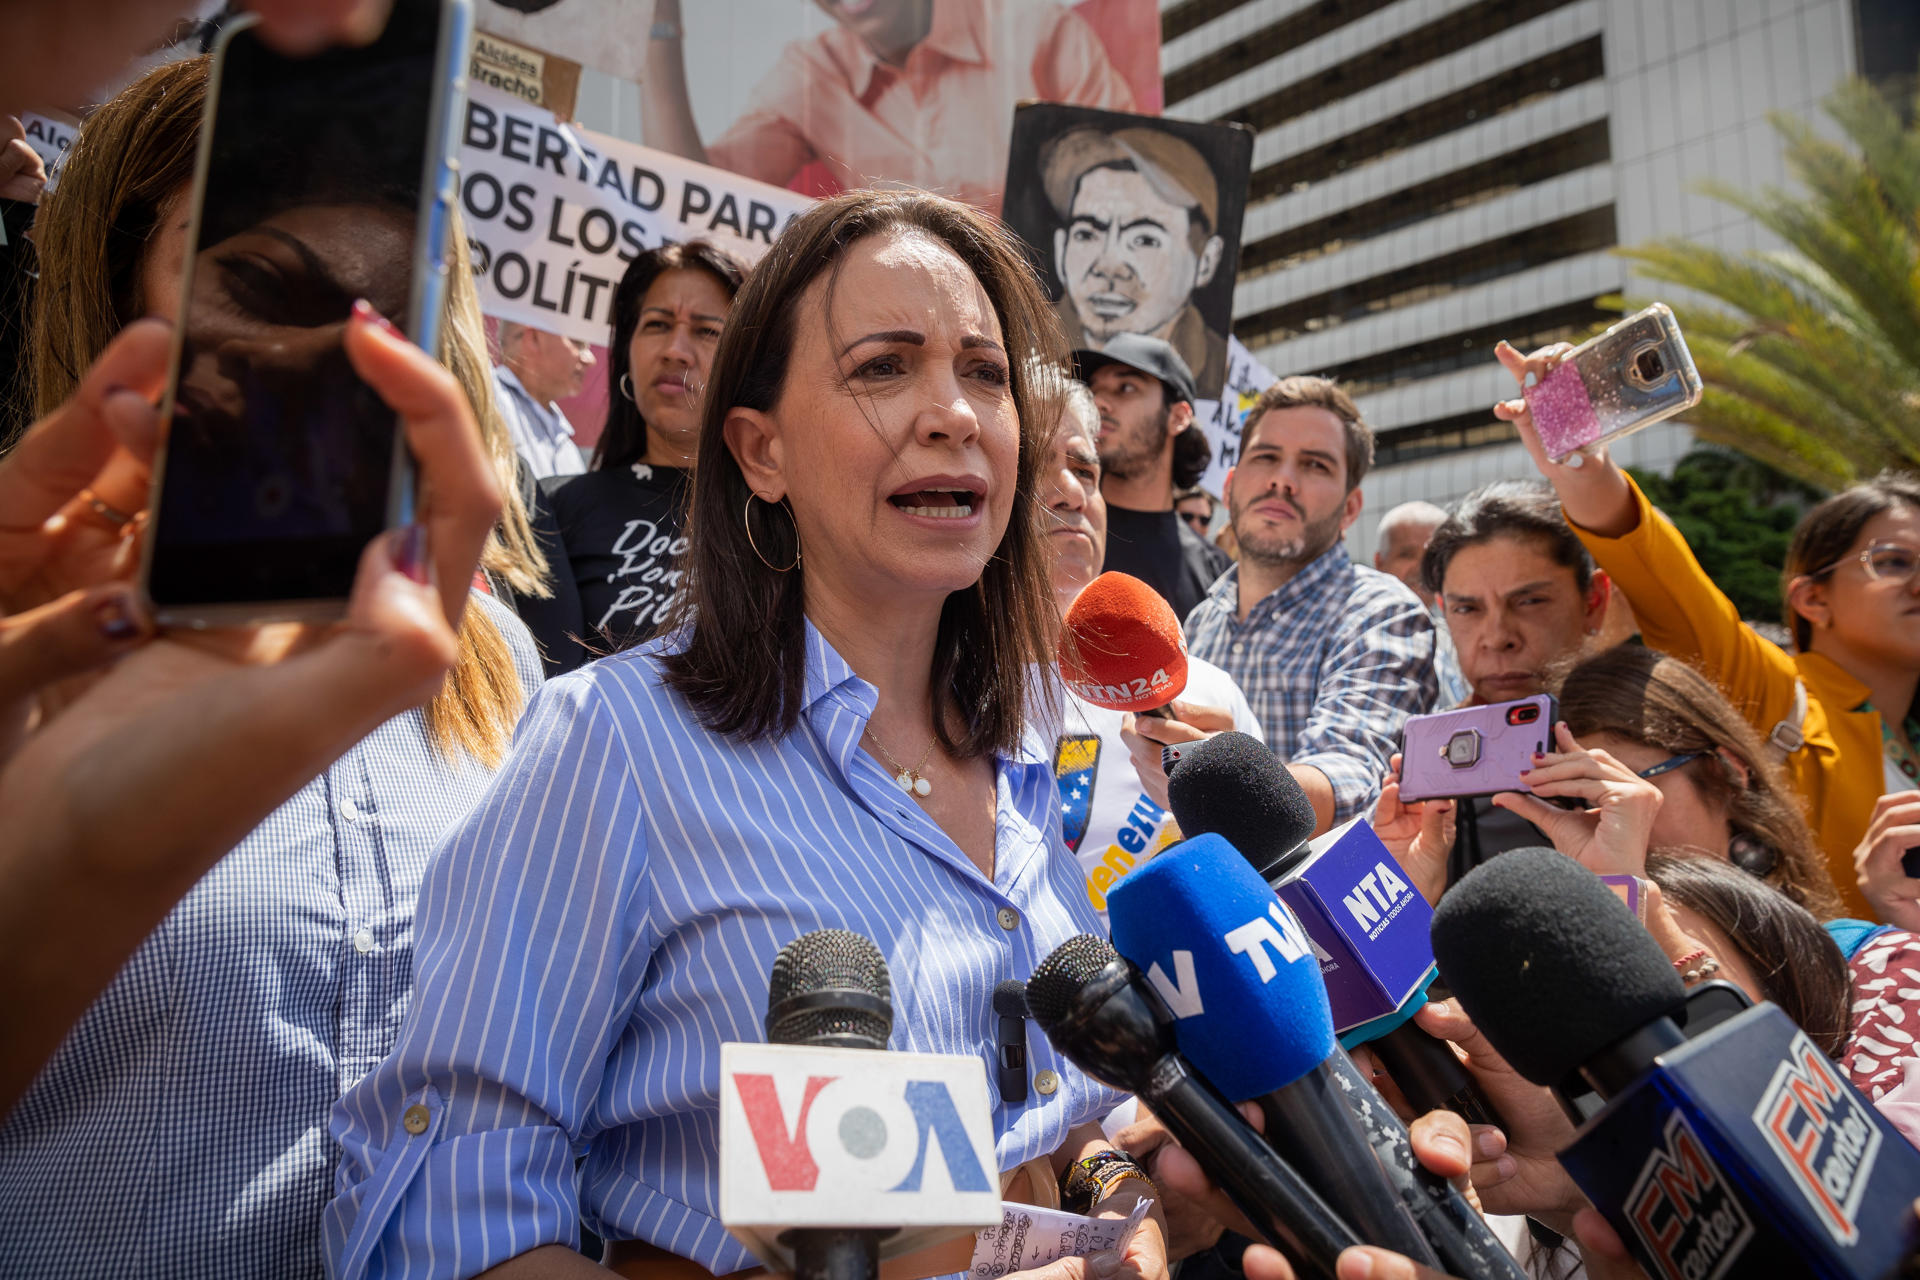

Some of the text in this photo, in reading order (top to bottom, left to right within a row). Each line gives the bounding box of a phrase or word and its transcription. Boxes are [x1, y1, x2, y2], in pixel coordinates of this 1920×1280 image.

[470, 61, 540, 100] Bracho
[475, 40, 537, 77] Alcides
[463, 99, 665, 212] BERTAD
[457, 172, 647, 264] OS LOS
[1067, 668, 1170, 699] NTN24
[1342, 861, 1409, 934] NTA
[1368, 890, 1415, 942] NOTICIAS TODOS AHORA
[732, 1072, 993, 1193] VOA
[1766, 1046, 1858, 1247] FM
